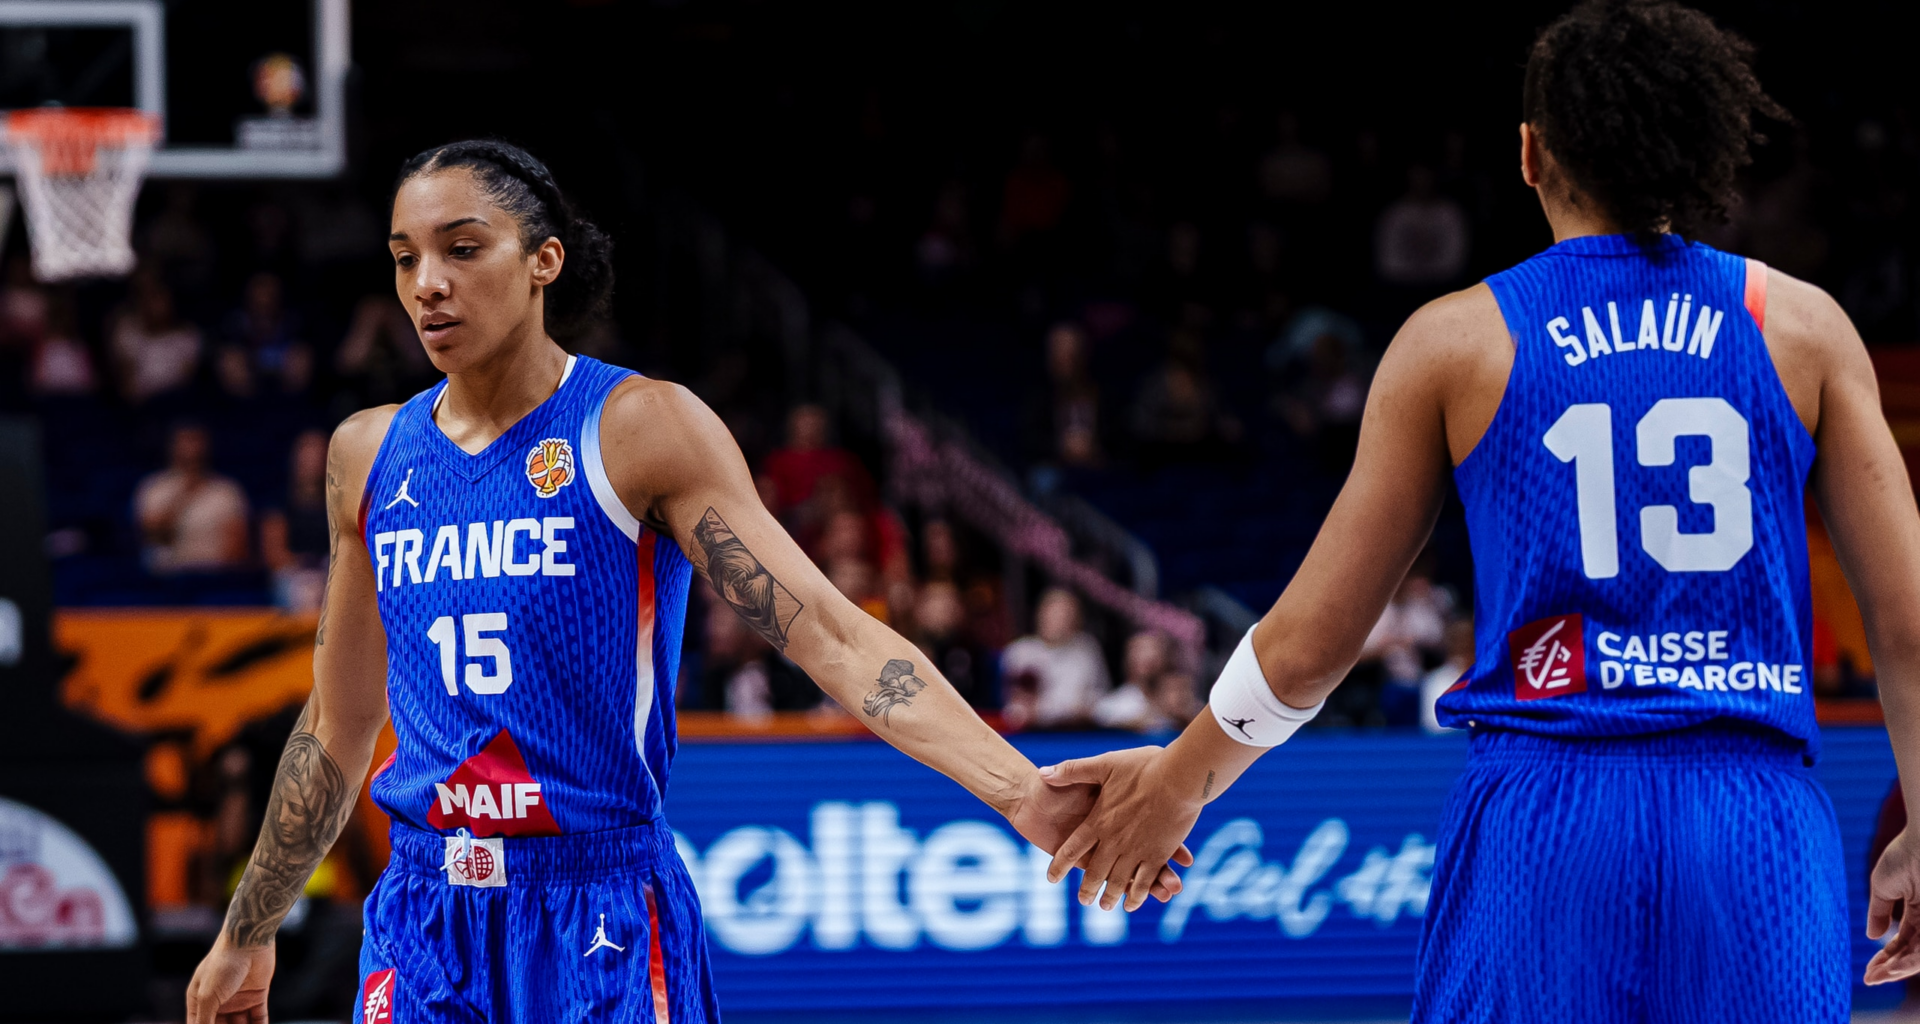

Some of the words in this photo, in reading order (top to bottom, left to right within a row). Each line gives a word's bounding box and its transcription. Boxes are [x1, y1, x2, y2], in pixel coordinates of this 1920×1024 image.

[1546, 292, 1724, 367] SALAÜN
[1543, 397, 1754, 579] 13
[375, 516, 576, 592] FRANCE
[426, 612, 513, 696] 15
[1596, 630, 1729, 663] CAISSE
[1600, 660, 1803, 694] D'EPARGNE
[434, 782, 542, 820] MAIF
[675, 800, 1129, 955] olten
